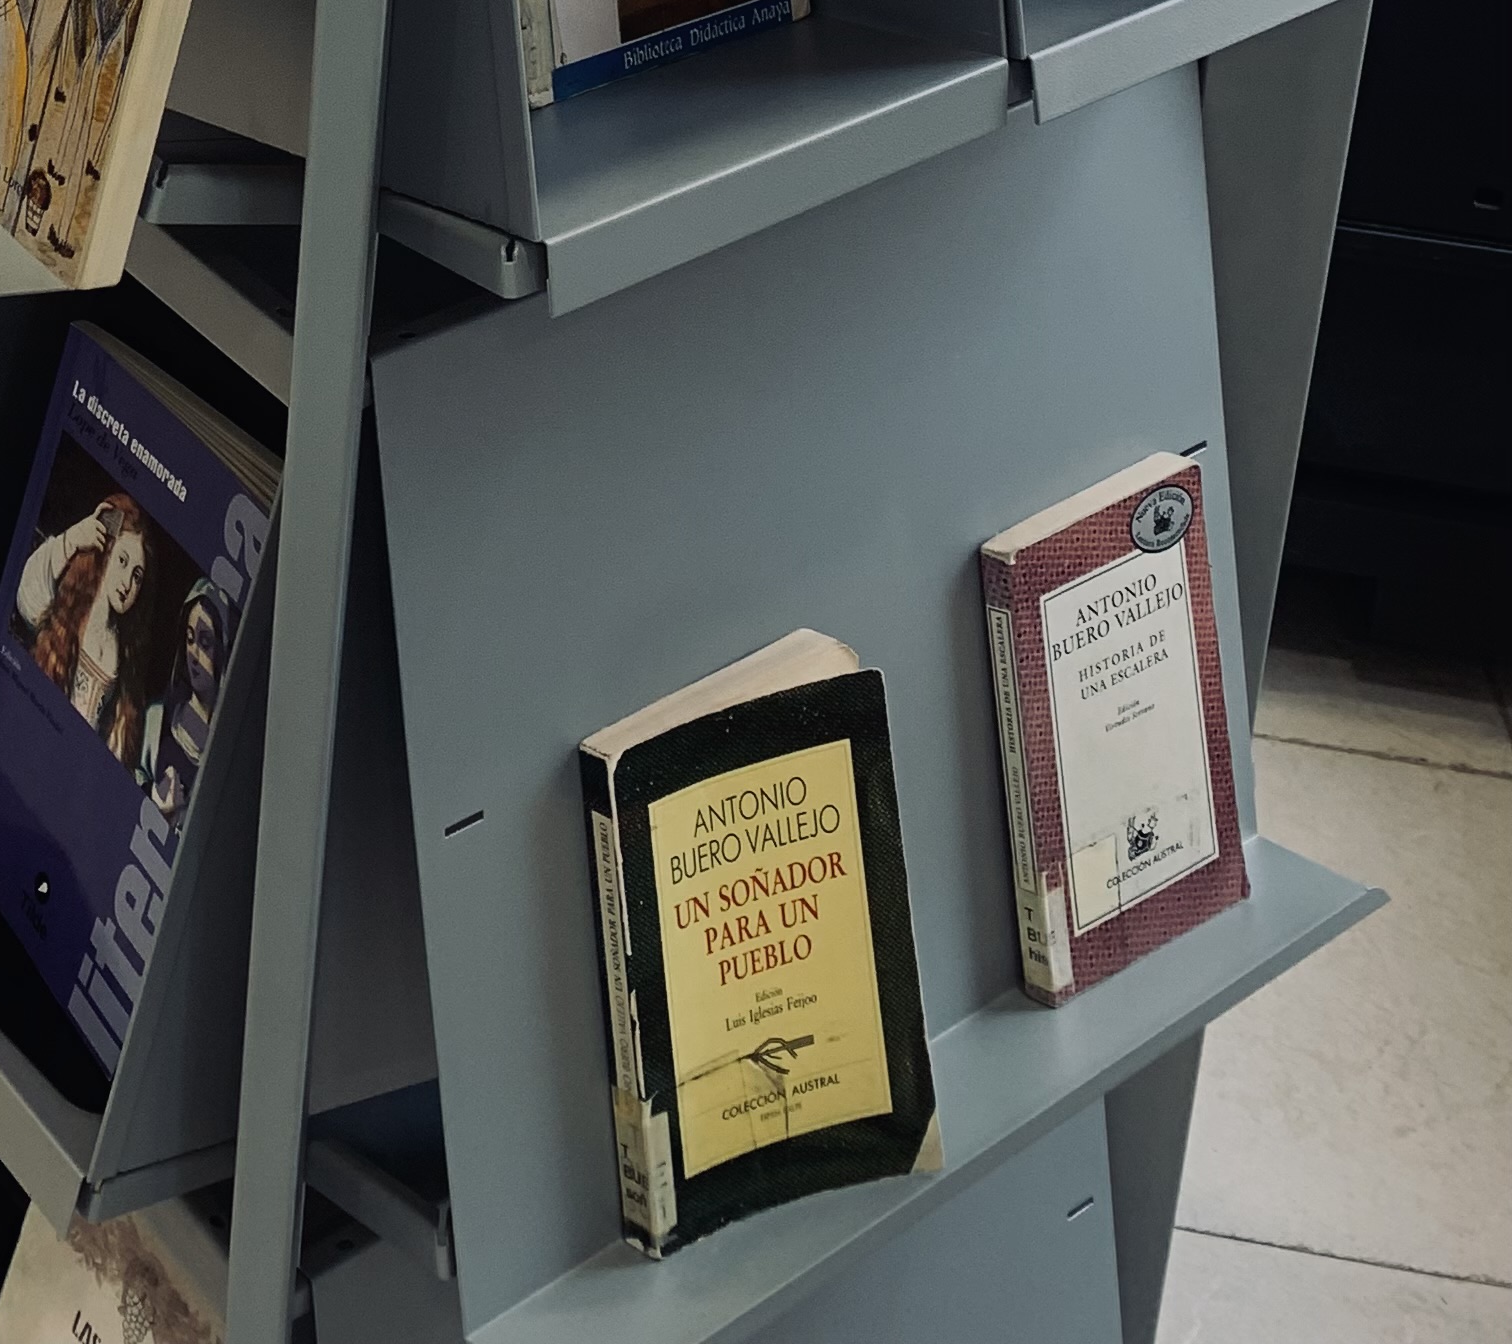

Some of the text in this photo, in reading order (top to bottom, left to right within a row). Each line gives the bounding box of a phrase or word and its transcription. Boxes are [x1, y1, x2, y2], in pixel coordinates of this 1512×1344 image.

[623, 0, 791, 70] Biblioteca Didáctica Anaya
[72, 379, 188, 503] La discreta enamorada
[1051, 581, 1184, 662] BUERO VALLEJO
[1076, 572, 1157, 627] ANTONIO
[1077, 629, 1166, 683] HISTORIA DE
[1080, 648, 1170, 701] UNA ESCALERA
[694, 776, 807, 838] ANTONIO
[670, 804, 841, 885] BUERO VALLEJO
[598, 821, 622, 973] SOÑADOR PARA PUEBLO
[675, 850, 848, 930] UN SOÑADOR
[1106, 858, 1152, 890] COLECCIÓN
[704, 894, 821, 956] PARA UN
[1024, 907, 1034, 922] T
[718, 934, 813, 987] PUEBLO
[725, 1001, 784, 1032] Luis Iglesias
[755, 987, 783, 1004] Edición
[721, 1091, 787, 1121] COLECCIÓN
[791, 1073, 841, 1098] AUSTRAL
